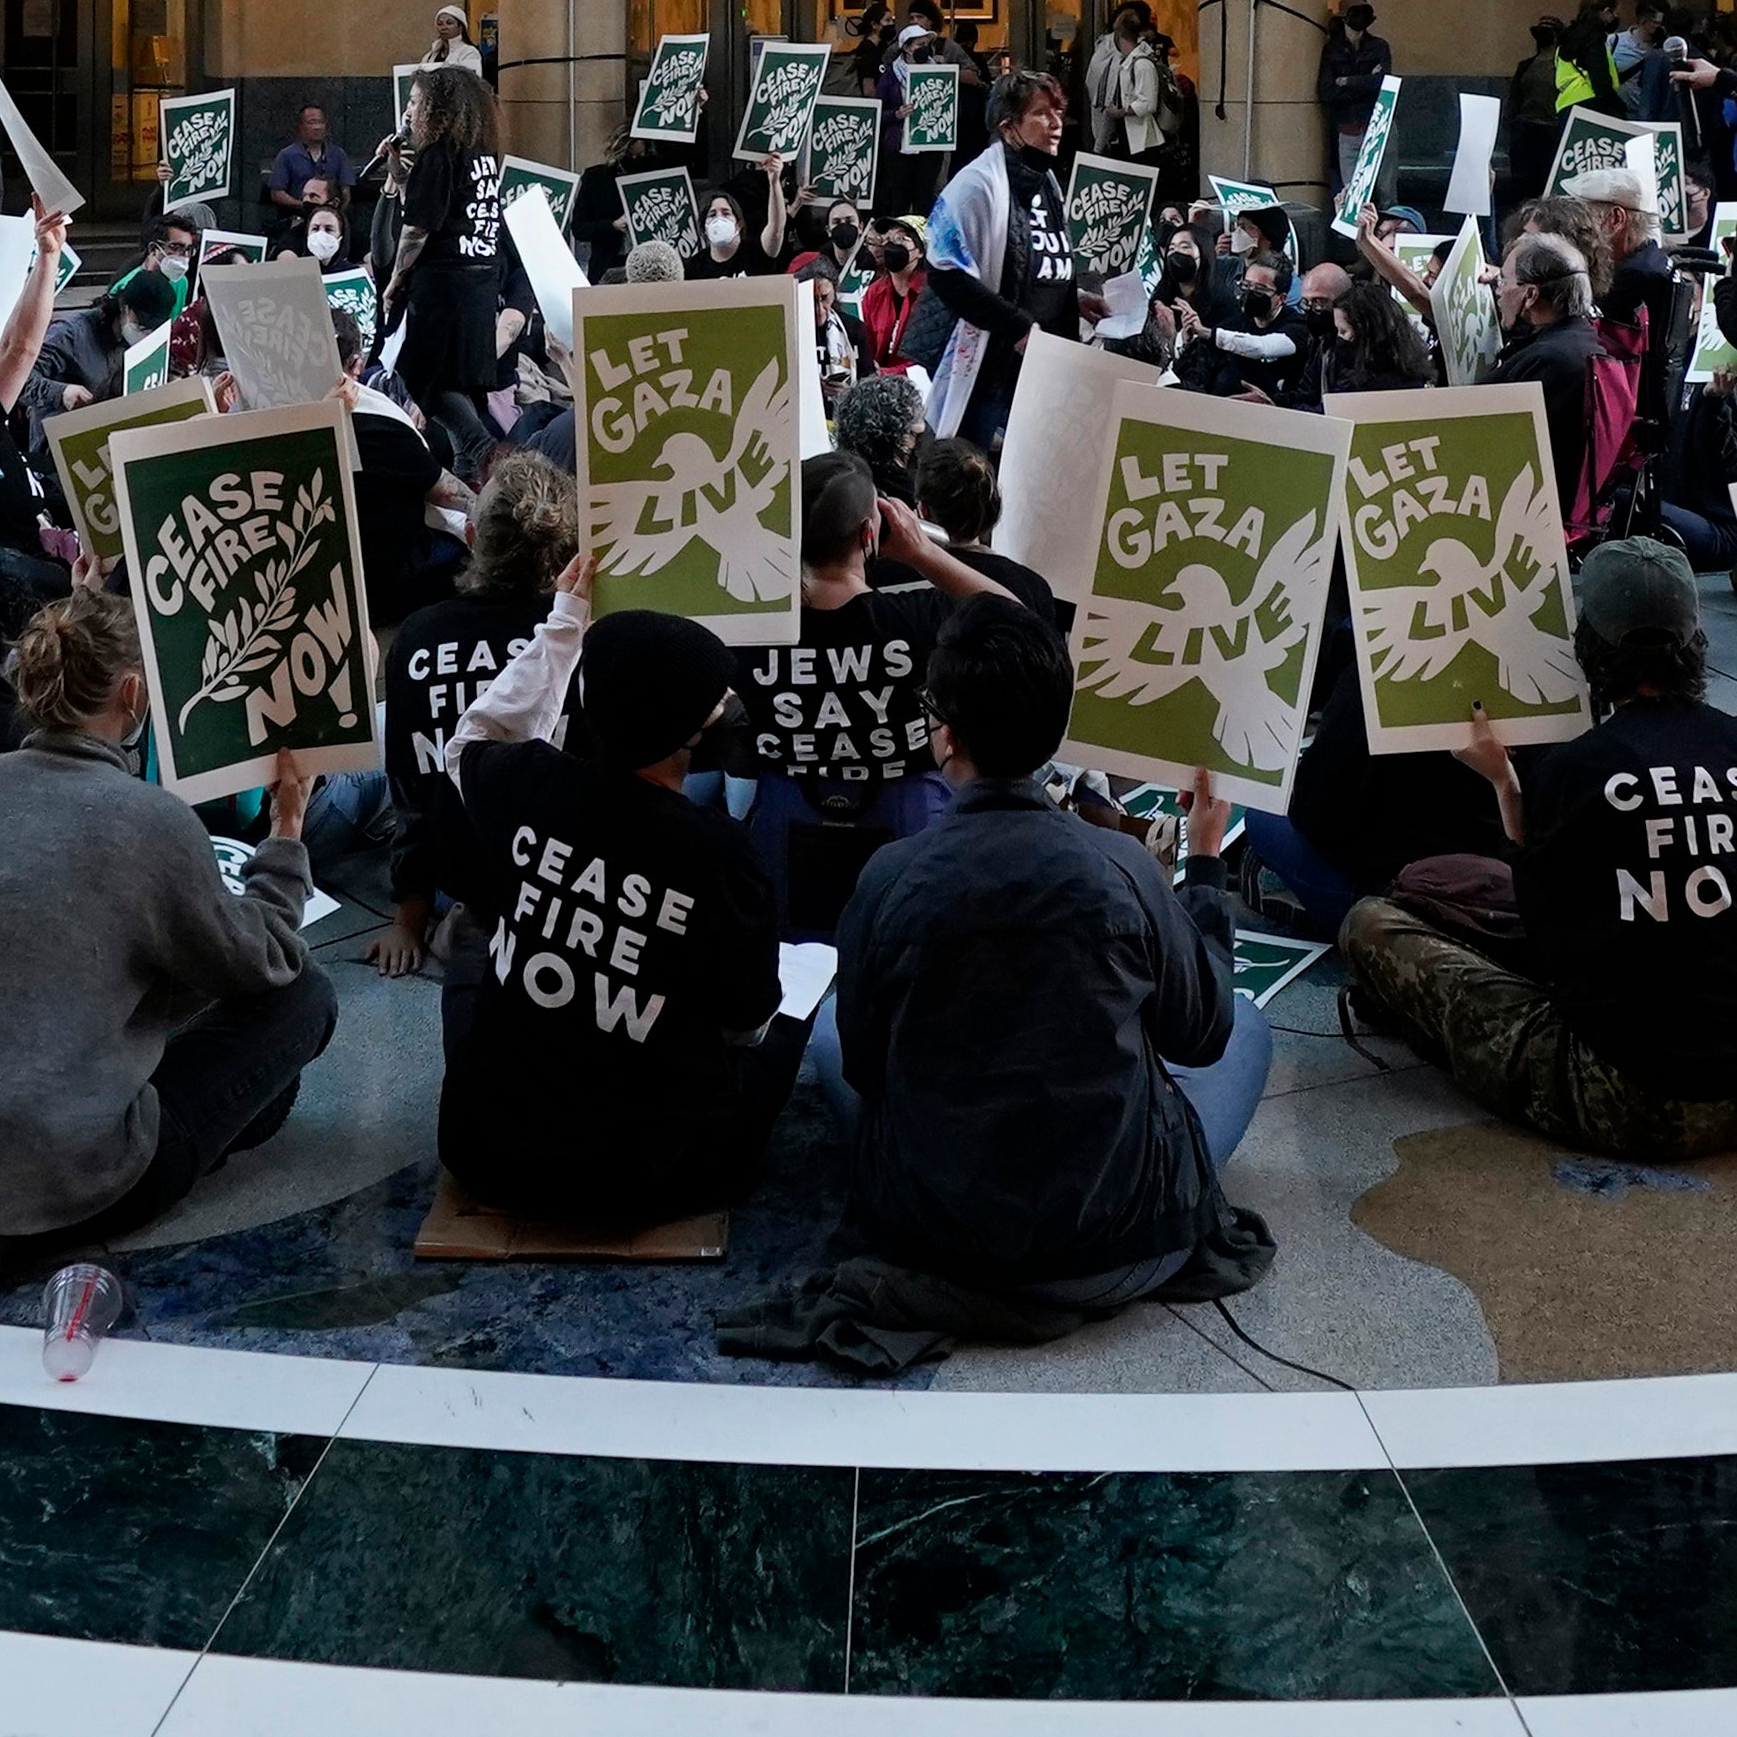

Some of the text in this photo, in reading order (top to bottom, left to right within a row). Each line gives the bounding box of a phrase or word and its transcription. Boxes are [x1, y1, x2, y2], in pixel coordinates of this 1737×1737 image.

[652, 51, 697, 87] CEASE
[663, 65, 691, 88] FIRE
[756, 62, 809, 105] CEASE
[769, 78, 801, 107] FIRE
[912, 78, 946, 111] CEASE
[919, 91, 942, 110] FIRE
[168, 112, 215, 159] CEASE
[182, 125, 211, 157] FIRE
[769, 97, 813, 152] NOW!
[813, 114, 861, 152] CEASE
[825, 129, 855, 154] FIRE
[926, 102, 955, 143] NOW!
[188, 138, 228, 193] NOW!
[832, 147, 873, 197] NOW!
[1562, 136, 1625, 172] CEASE
[631, 187, 674, 233] CEASE
[645, 201, 673, 233] FIRE
[1071, 180, 1131, 221] CEASE
[1085, 199, 1120, 227] FIRE
[589, 328, 691, 392] LET
[591, 367, 734, 455] GAZA
[633, 428, 781, 536] LIVE
[1119, 452, 1230, 502] LET
[1347, 434, 1443, 501] LET
[1106, 497, 1266, 570] GAZA
[1353, 473, 1493, 561] GAZA
[144, 470, 286, 617] CEASE
[189, 514, 278, 613] FIRE
[1406, 532, 1542, 642] LIVE
[1127, 579, 1294, 667] LIVE
[243, 561, 358, 747] NOW!
[753, 638, 913, 687] JEWS
[773, 685, 895, 730] SAY
[756, 716, 930, 762] CEASE
[511, 824, 696, 937] CEASE
[514, 885, 648, 977] FIRE
[489, 915, 666, 1045] NOW
